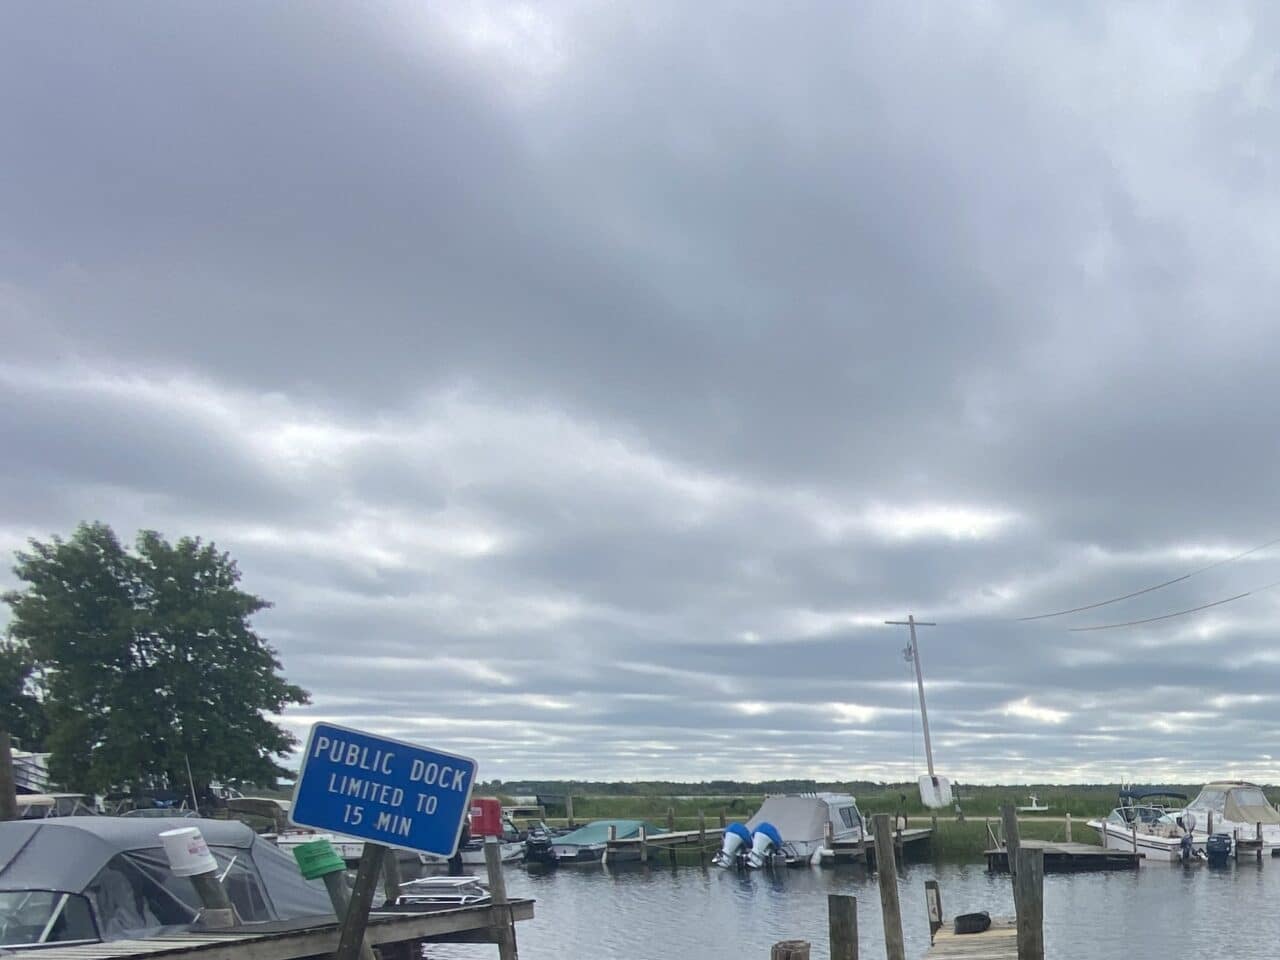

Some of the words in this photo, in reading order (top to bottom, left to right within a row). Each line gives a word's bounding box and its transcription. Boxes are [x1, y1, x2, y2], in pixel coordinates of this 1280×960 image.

[314, 736, 395, 775] PUBLIC
[410, 759, 466, 792] DOCK
[328, 773, 404, 807] LIMITED
[416, 793, 438, 815] TO
[343, 804, 364, 825] 15
[377, 811, 413, 837] MIN
